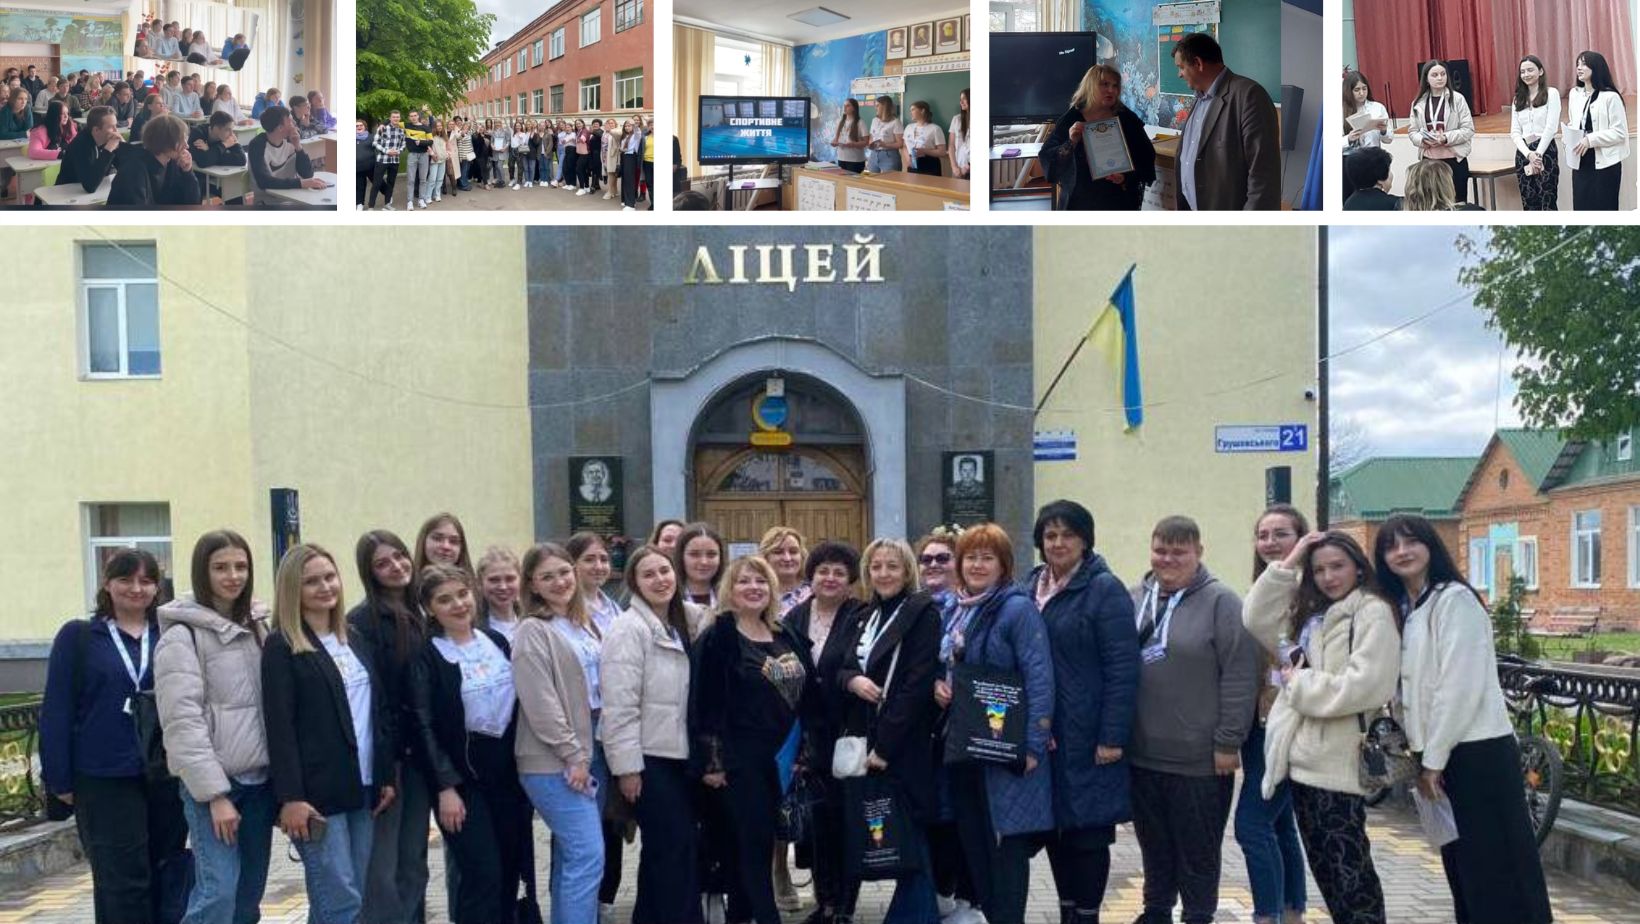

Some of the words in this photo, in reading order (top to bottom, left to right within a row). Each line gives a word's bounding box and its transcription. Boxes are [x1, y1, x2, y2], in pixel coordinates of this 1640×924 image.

[730, 118, 783, 126] СПОРТИВНЕ
[740, 129, 772, 137] ЖИТТЯ
[684, 233, 885, 292] ЛІЦЕЙ
[1282, 429, 1304, 446] 21
